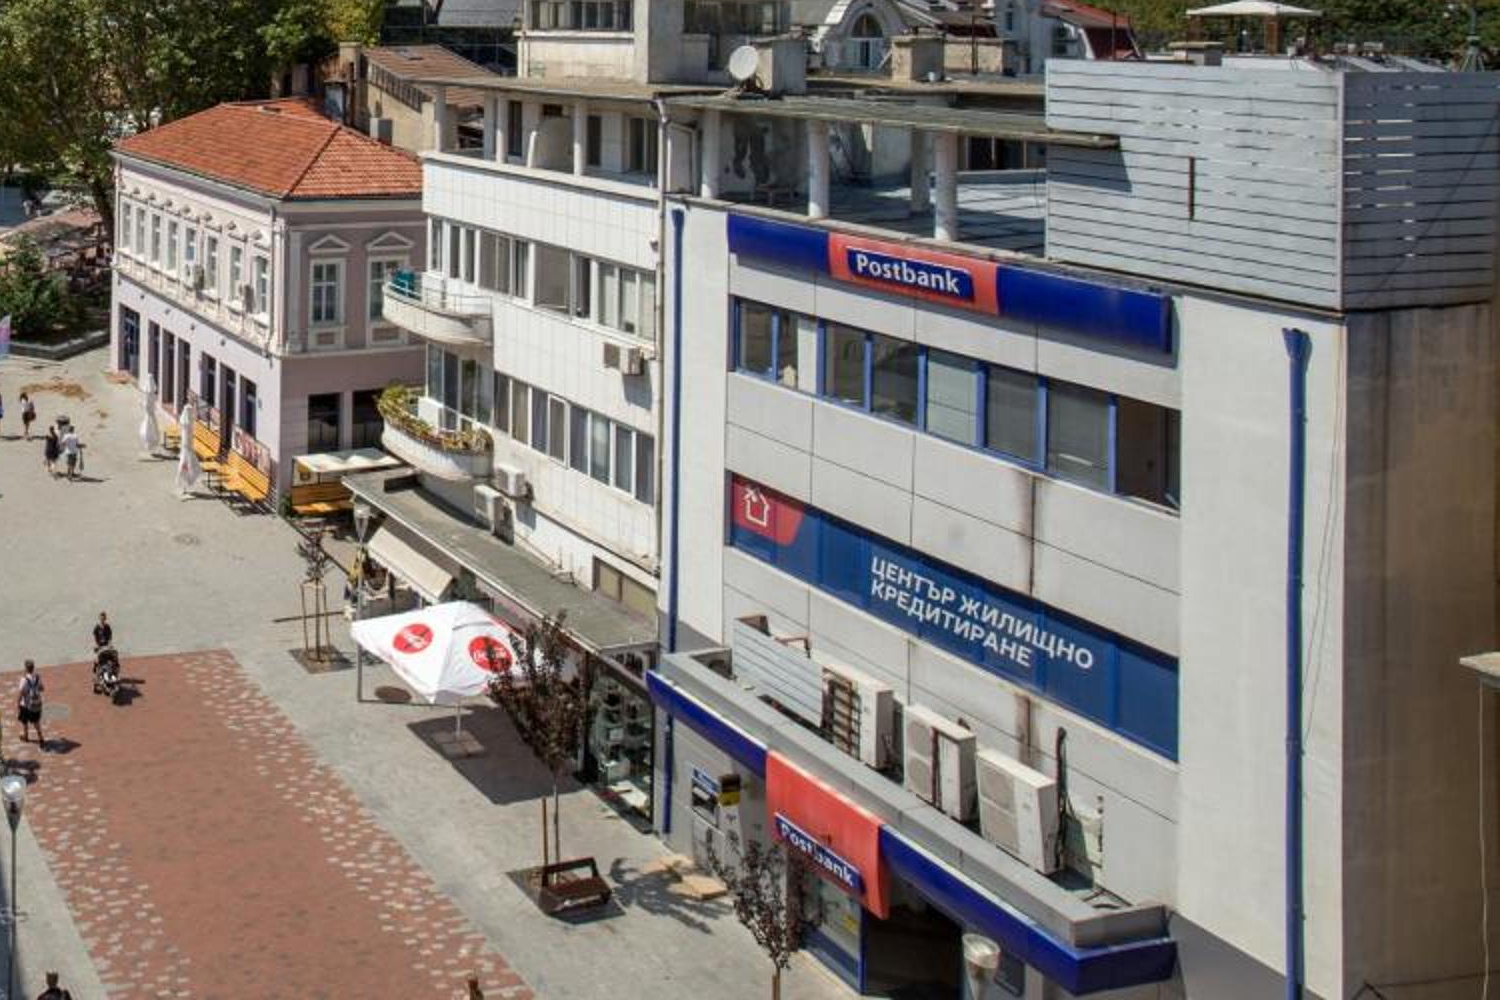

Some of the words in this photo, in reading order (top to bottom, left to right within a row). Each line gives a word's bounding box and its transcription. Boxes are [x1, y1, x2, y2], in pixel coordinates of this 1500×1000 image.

[856, 253, 960, 295] Postbank
[871, 556, 956, 605] ЦЕНТЪР
[959, 594, 1094, 670] ЖИЛИЩНО
[871, 579, 1033, 668] КРЕДИТИРАНЕ
